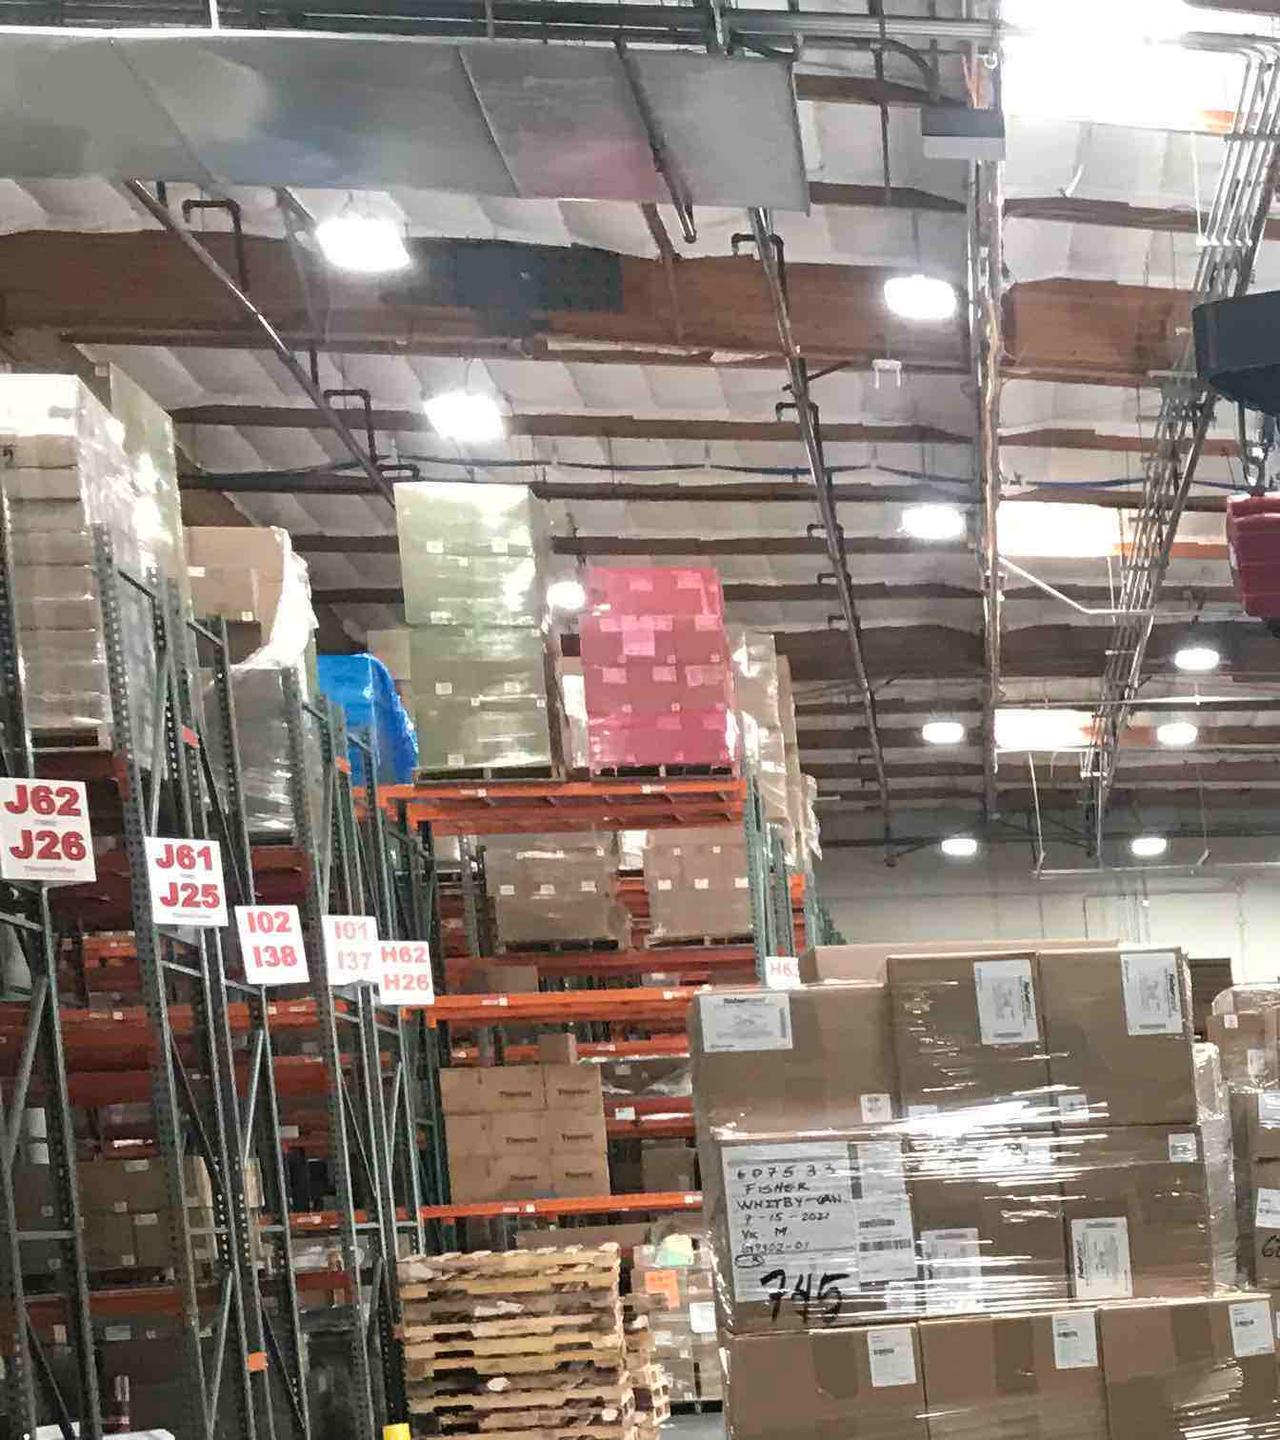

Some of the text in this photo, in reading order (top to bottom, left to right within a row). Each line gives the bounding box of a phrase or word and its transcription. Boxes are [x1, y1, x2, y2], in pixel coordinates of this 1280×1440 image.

[4, 784, 81, 816] J62
[9, 829, 86, 861] J26
[156, 844, 212, 870] J61
[160, 882, 220, 908] J25
[247, 911, 292, 934] I02
[334, 921, 368, 940] I01
[253, 945, 298, 968] I38
[337, 952, 371, 970] I37
[381, 946, 427, 963] H62
[384, 974, 429, 990] H26
[744, 1182, 810, 1195] FISHER
[760, 1269, 849, 1323] 745
